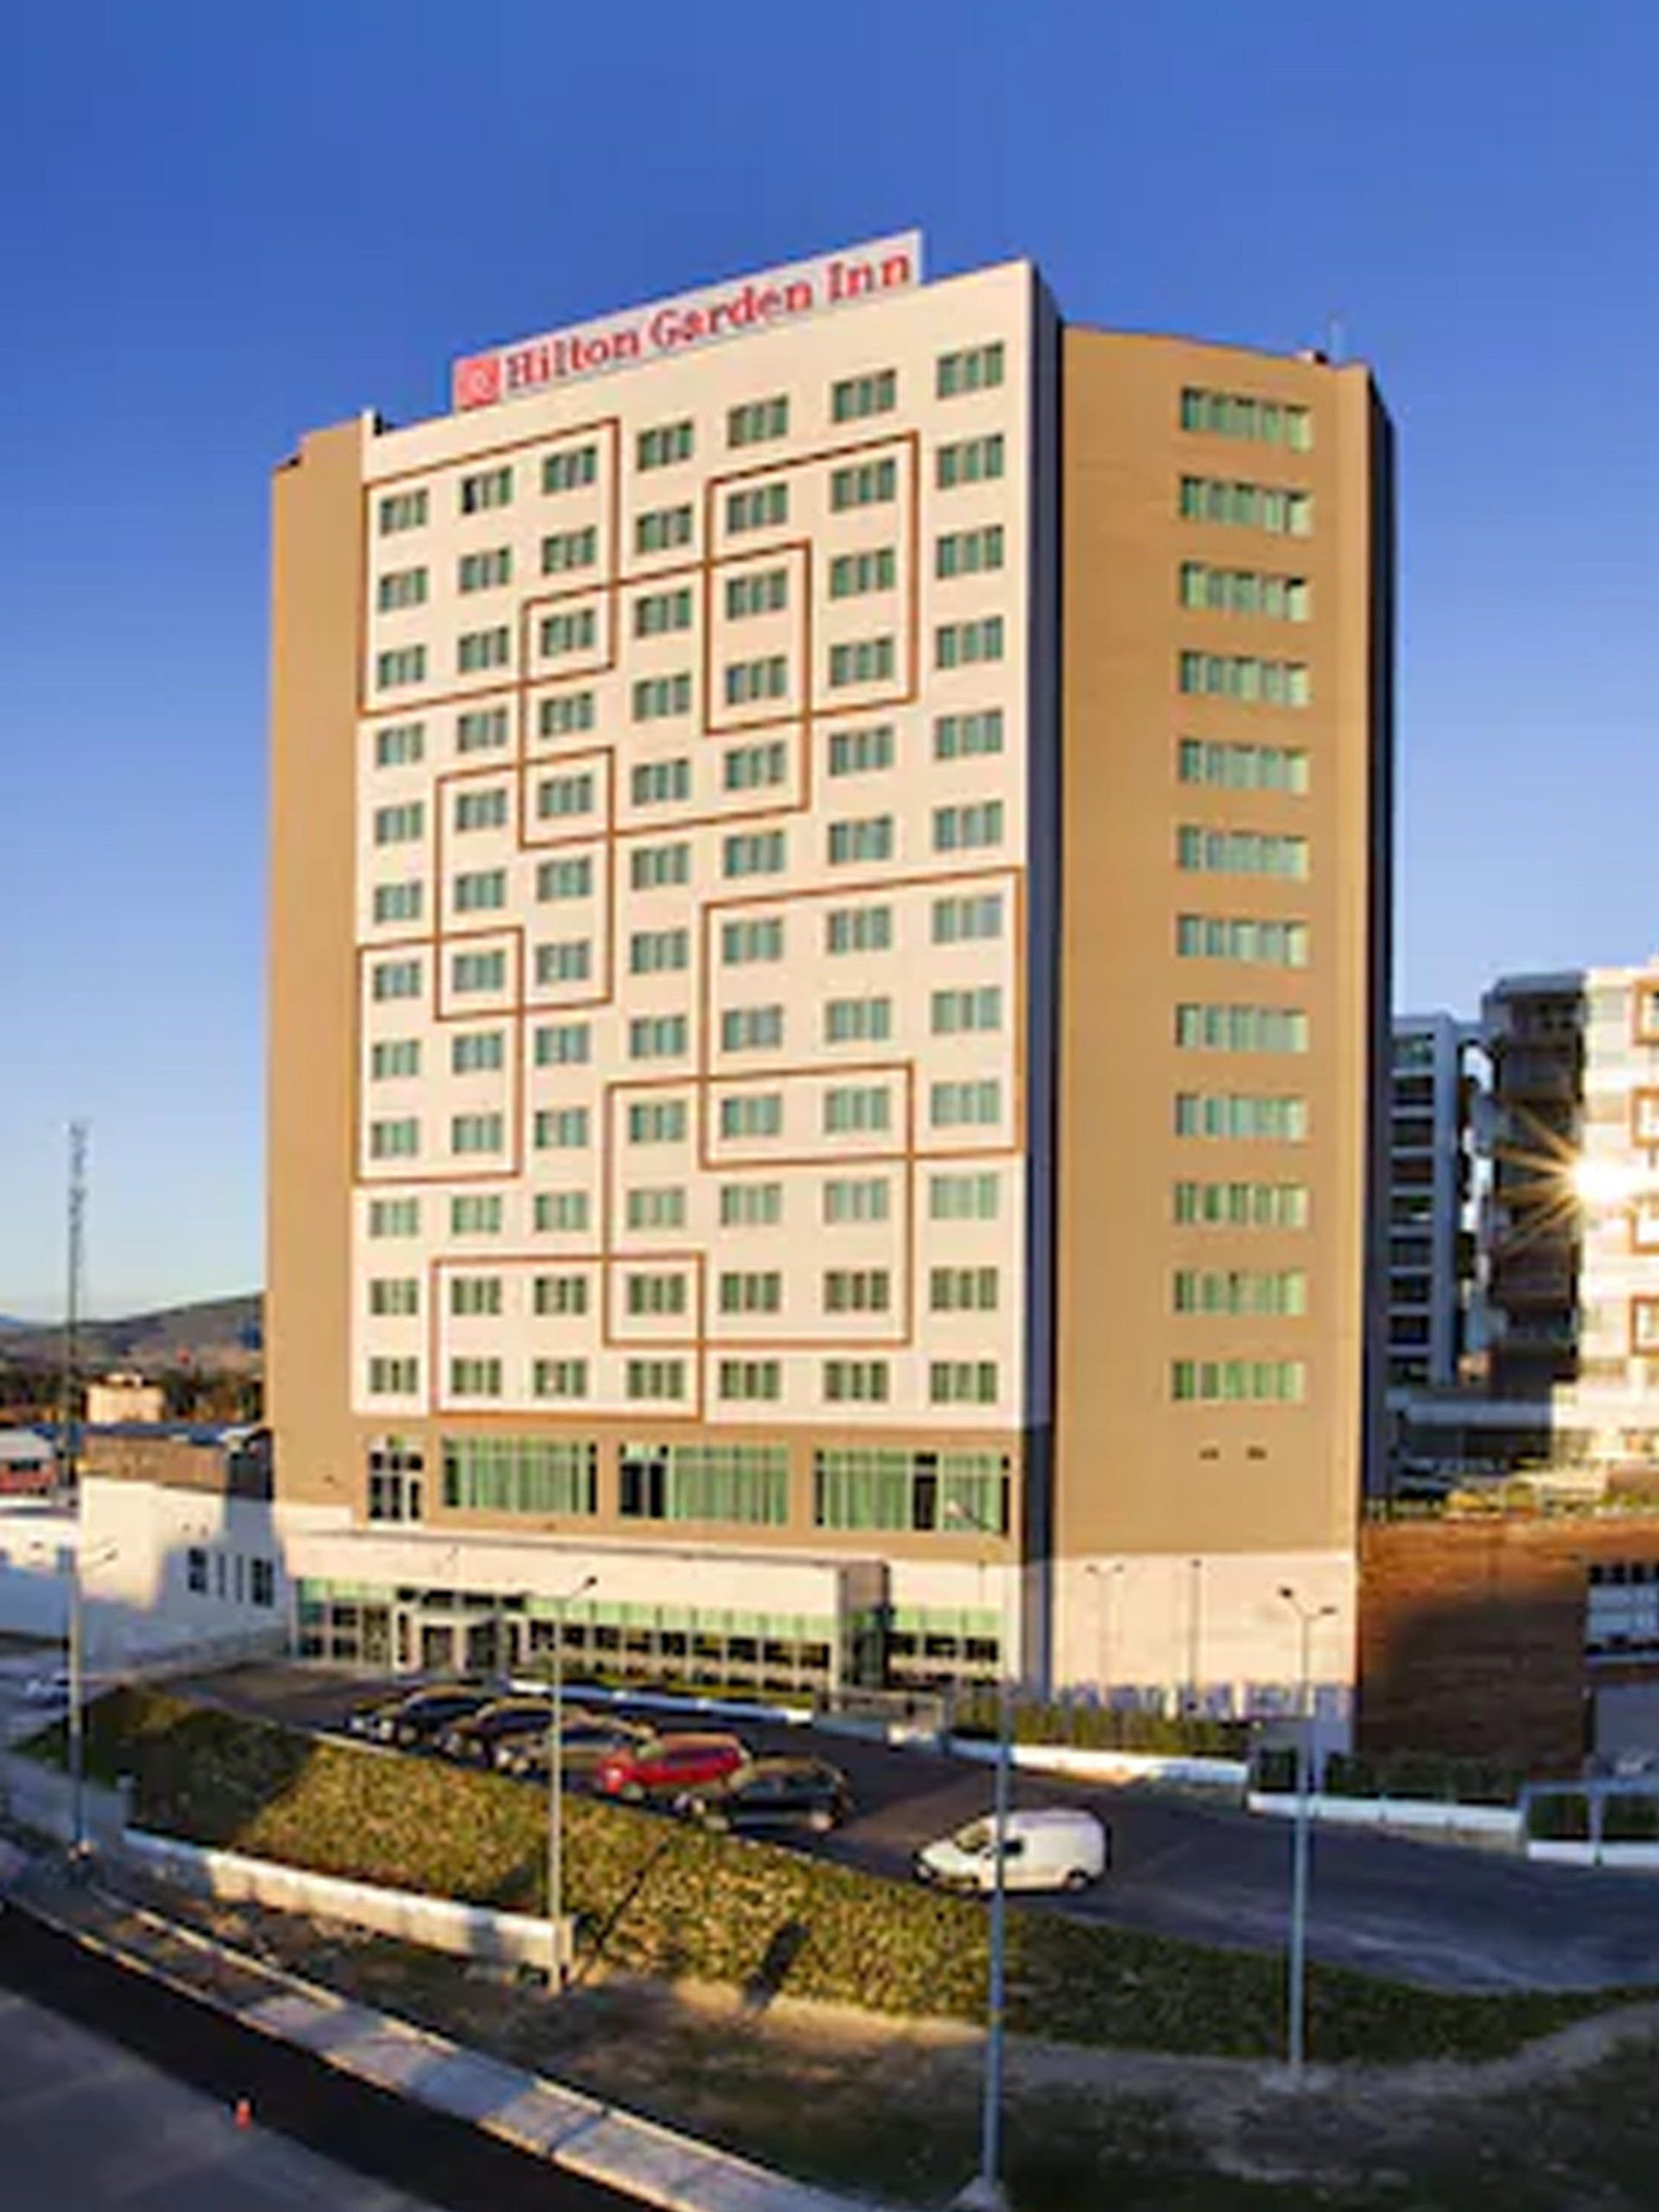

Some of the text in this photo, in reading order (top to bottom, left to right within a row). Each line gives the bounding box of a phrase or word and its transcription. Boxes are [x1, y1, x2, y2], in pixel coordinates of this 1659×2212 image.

[505, 252, 912, 389] Hilton Garden Inn
